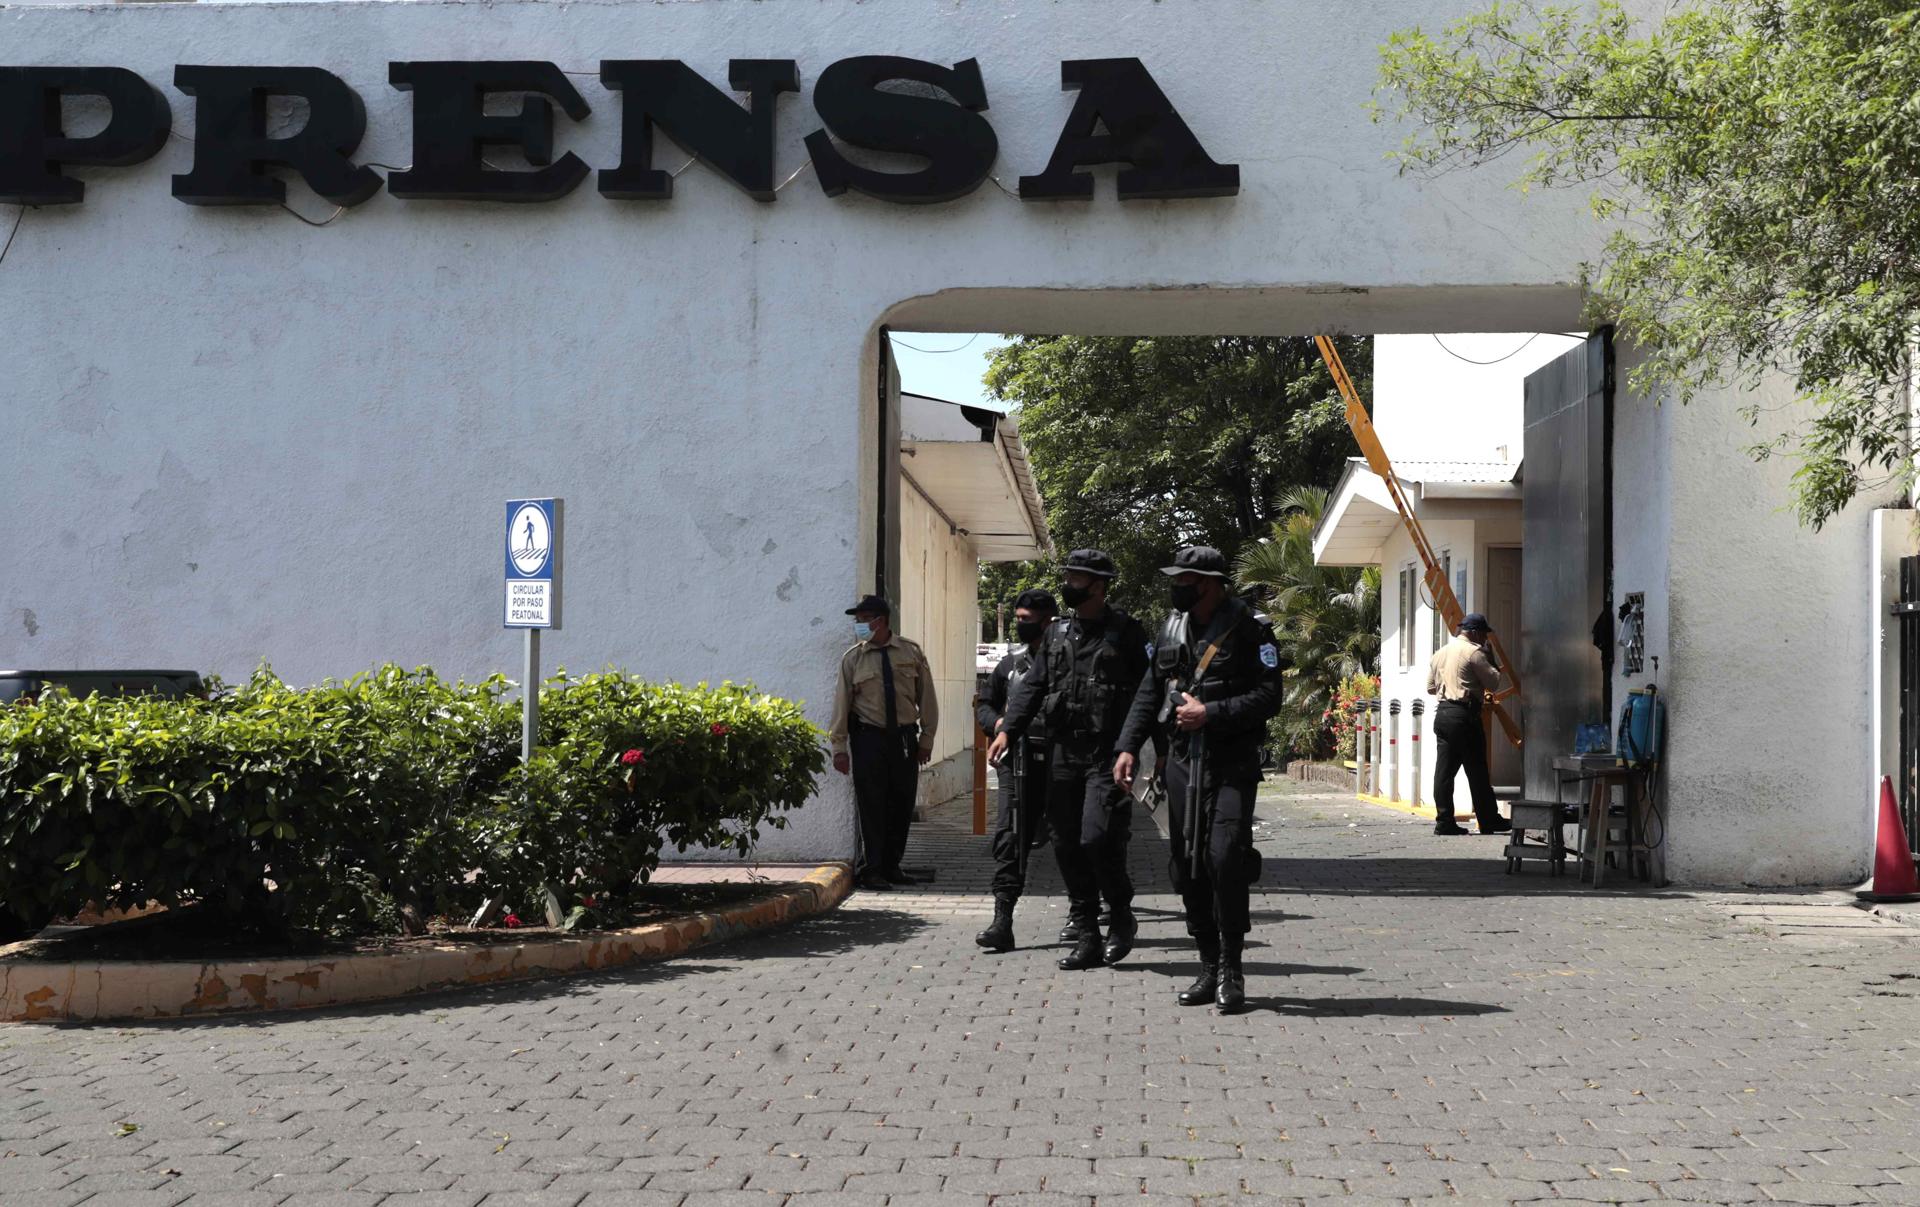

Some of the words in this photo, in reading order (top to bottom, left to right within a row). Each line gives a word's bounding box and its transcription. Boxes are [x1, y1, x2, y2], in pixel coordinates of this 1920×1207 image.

[0, 55, 1240, 207] PRENSA
[512, 584, 544, 595] CIRCULAR
[512, 597, 526, 607] POR
[527, 597, 544, 607] PASO
[511, 609, 545, 620] PEATONAL
